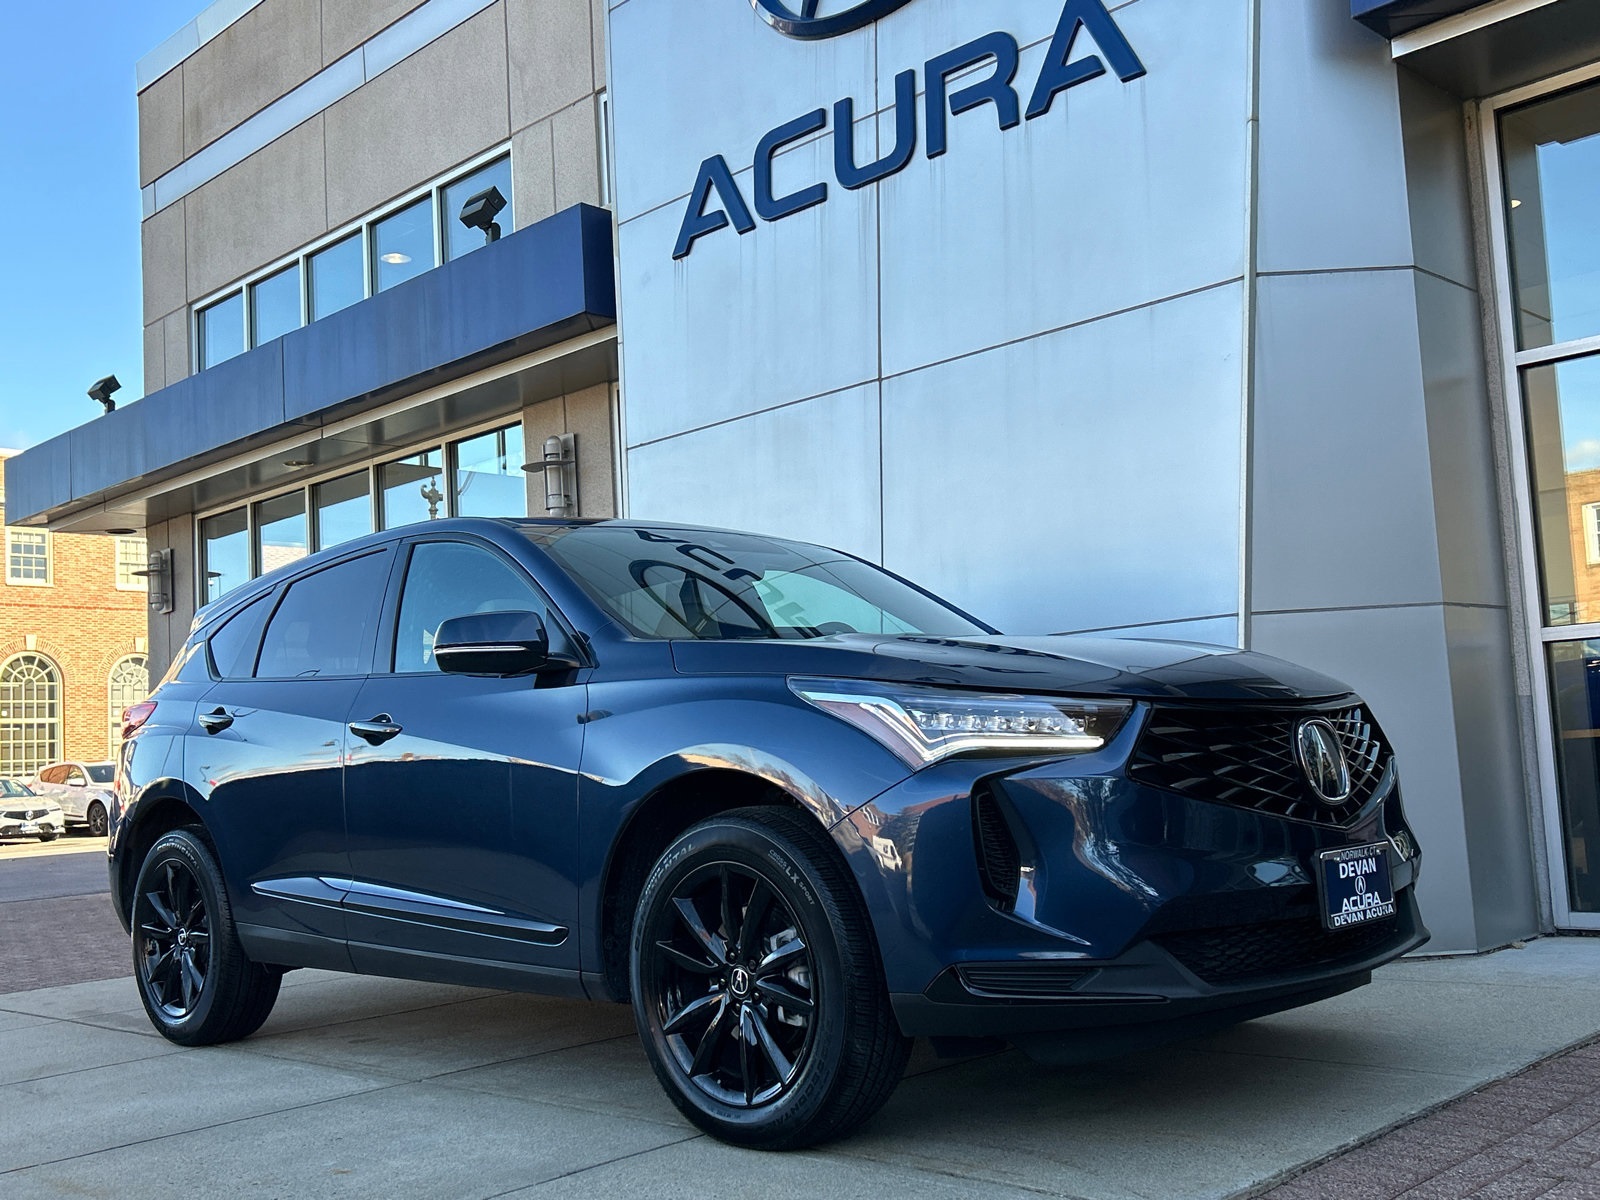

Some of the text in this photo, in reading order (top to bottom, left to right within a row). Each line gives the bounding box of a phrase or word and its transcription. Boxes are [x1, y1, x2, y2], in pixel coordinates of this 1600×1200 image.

[672, 0, 1147, 261] ACURA
[1341, 848, 1368, 860] NORWALK
[1339, 857, 1377, 879] DEVAN
[785, 865, 800, 884] LX
[798, 881, 815, 905] SPORT
[1342, 891, 1381, 913] ACURA
[1334, 904, 1394, 927] DEVAN ACURA
